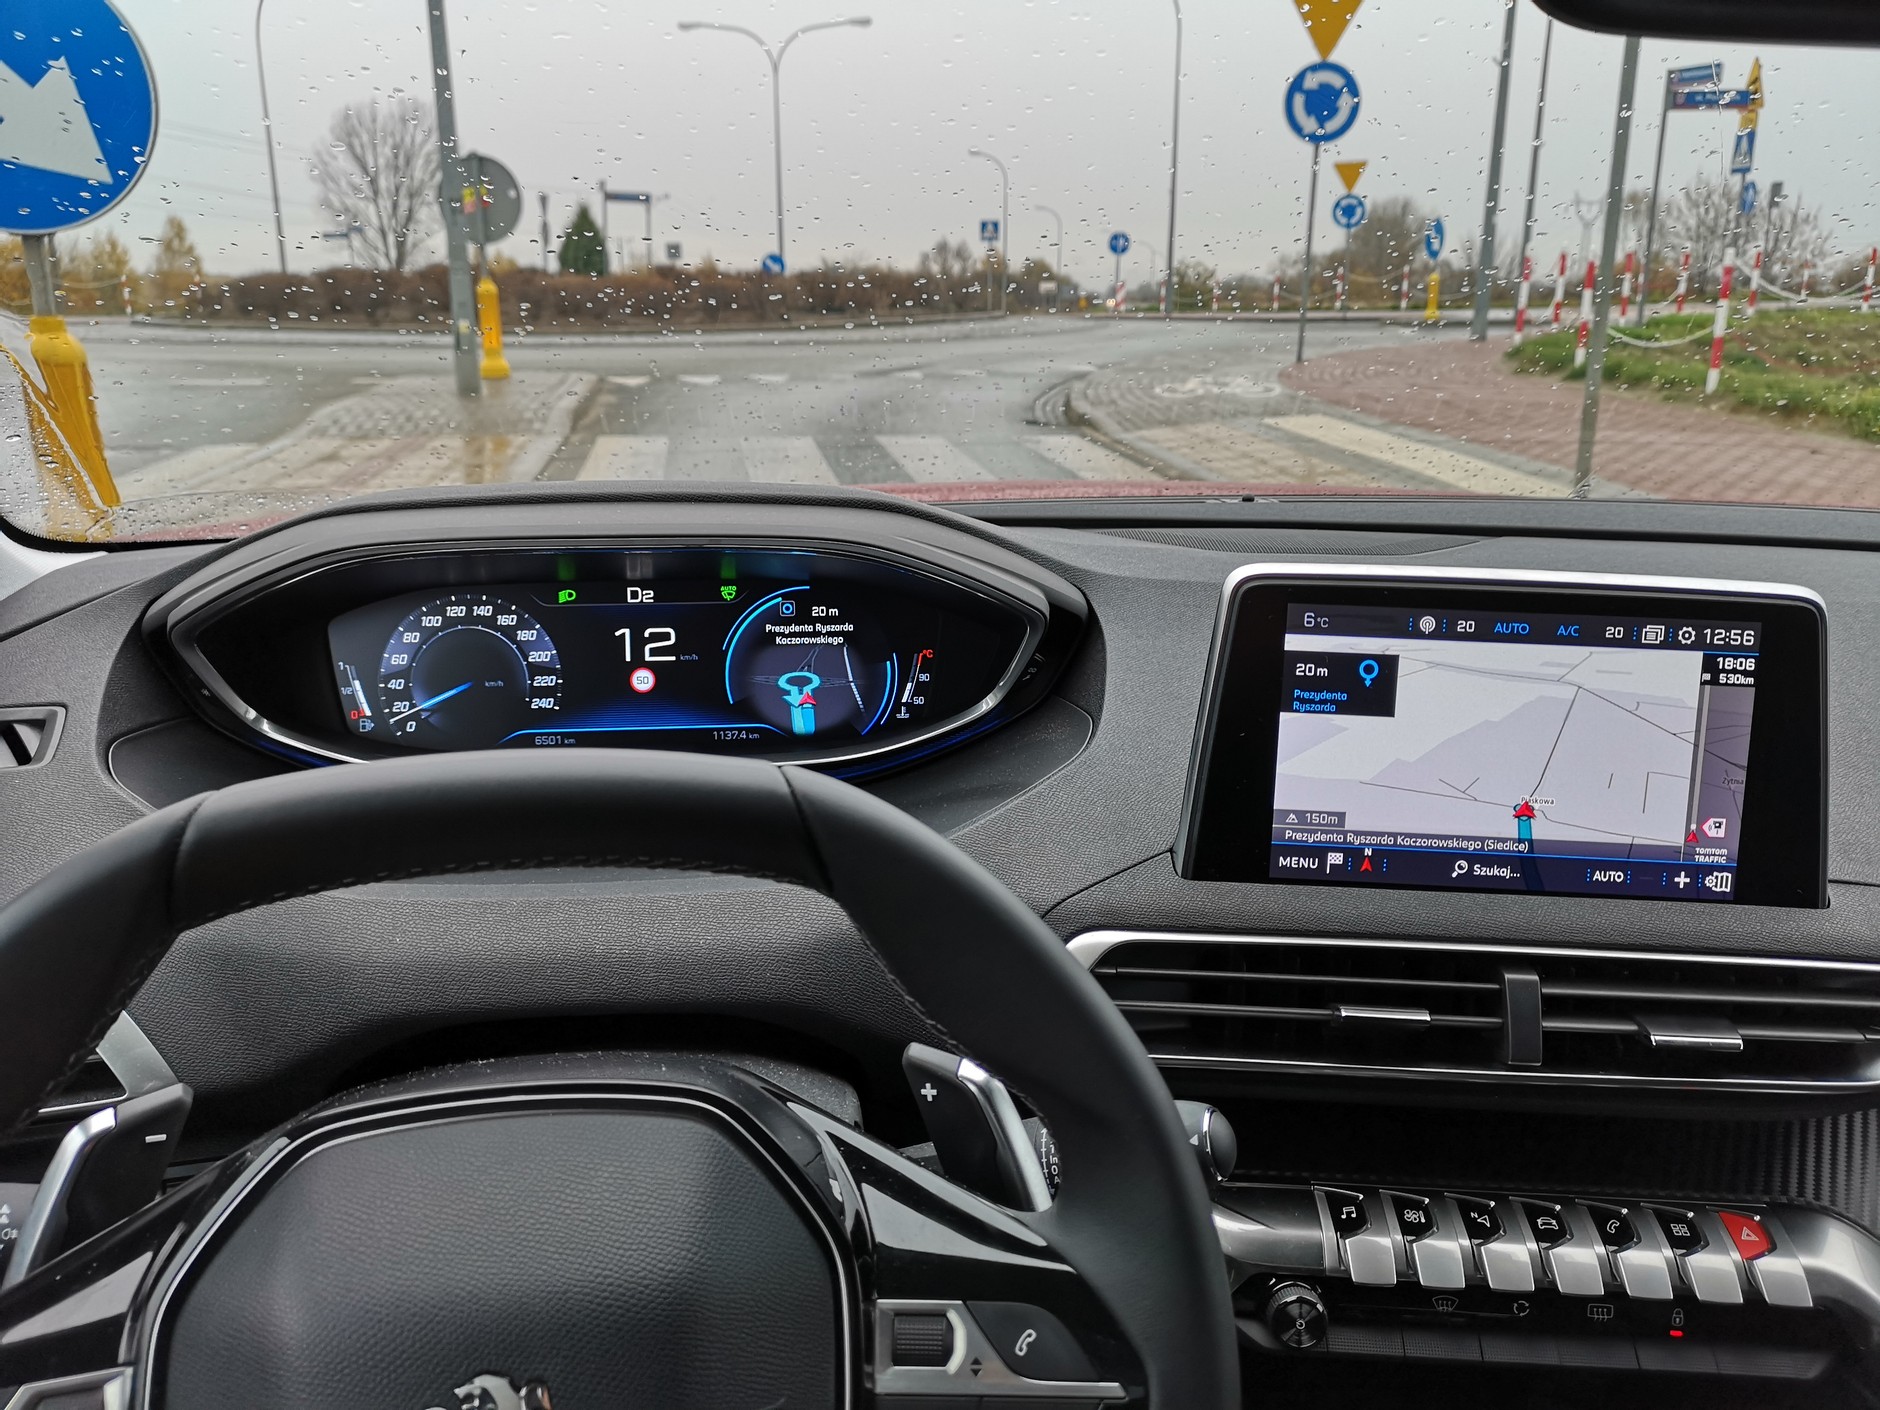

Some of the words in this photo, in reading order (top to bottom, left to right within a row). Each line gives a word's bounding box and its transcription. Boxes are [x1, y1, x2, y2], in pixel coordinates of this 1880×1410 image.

[446, 606, 466, 617] 120
[472, 605, 493, 616] 140
[811, 606, 827, 617] 20
[828, 608, 839, 617] m
[421, 616, 442, 627] 100
[496, 615, 517, 626] 160
[765, 624, 814, 635] Prezydenta
[815, 622, 854, 633] Ryszarda
[1457, 620, 1475, 633] 20
[1494, 622, 1530, 635] AUTO
[1557, 625, 1580, 637] A/C
[403, 632, 421, 643] 80
[516, 630, 537, 641] 180
[1605, 626, 1624, 639] 20
[1703, 628, 1755, 646] 12:56
[614, 627, 677, 662] 12
[680, 654, 699, 662] km/h
[775, 634, 844, 645] Kaczorowskiego
[391, 654, 408, 665] 60
[528, 651, 551, 662] 200
[1716, 657, 1756, 671] 18:06
[533, 676, 557, 687] 220
[636, 675, 650, 685] 50
[918, 673, 930, 681] 90
[387, 679, 405, 690] 40
[913, 696, 925, 705] 50
[1294, 689, 1347, 702] Prezydenta
[392, 701, 410, 712] 20
[531, 698, 554, 709] 240
[1293, 701, 1336, 713] Ryszarda
[350, 710, 359, 719] 0
[406, 721, 417, 732] 0
[535, 735, 562, 746] 6501
[564, 737, 576, 745] km
[712, 730, 747, 741] 1137.4
[748, 732, 760, 740] km
[1285, 830, 1344, 843] Prezydenta
[1346, 833, 1394, 846] Ryszarda
[1397, 835, 1482, 851] Kaczorowskiego
[1484, 839, 1529, 853] (Siedlce)
[1364, 847, 1373, 857] N
[1279, 856, 1319, 869] MENU
[1694, 855, 1727, 864] TRAFFIC
[1473, 864, 1521, 879] Szukaj...
[1592, 870, 1624, 883] AUTO
